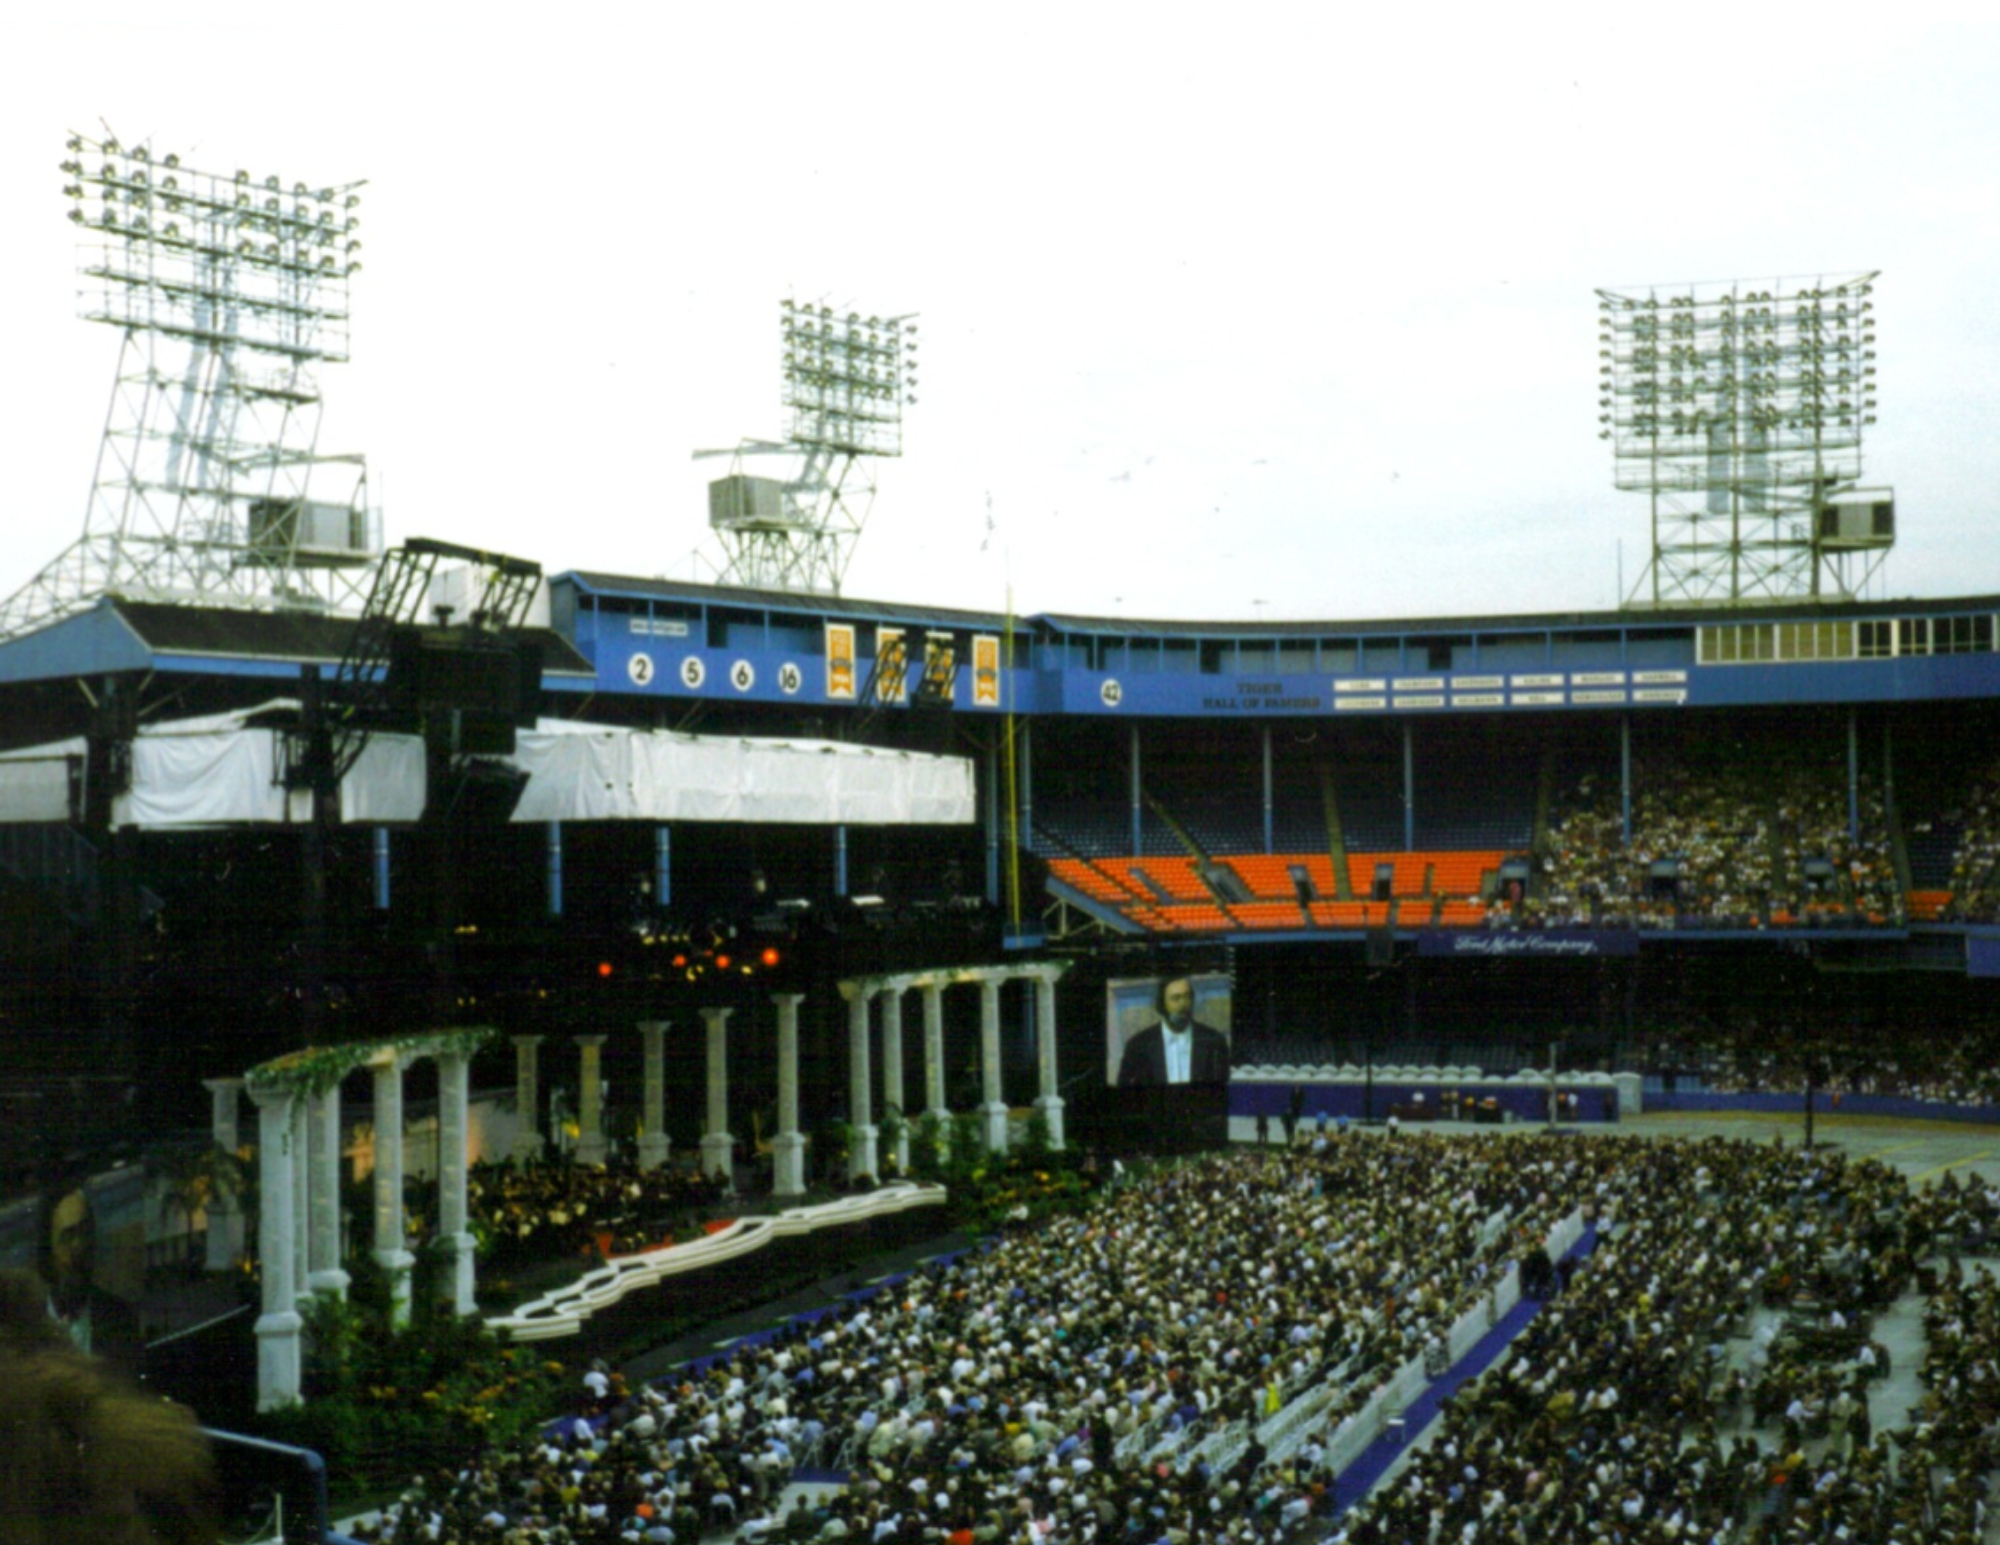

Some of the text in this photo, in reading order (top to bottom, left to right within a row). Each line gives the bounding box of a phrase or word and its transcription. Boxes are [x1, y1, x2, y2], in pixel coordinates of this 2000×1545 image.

[635, 657, 647, 681] 2
[687, 660, 699, 684] 5
[736, 664, 749, 687] 6
[781, 666, 798, 689] 16
[1103, 683, 1119, 701] 42
[1236, 683, 1283, 694] TIGER
[1203, 698, 1239, 709] HALL
[1242, 697, 1260, 709] OF
[1454, 935, 1489, 952] Ford
[1488, 935, 1530, 954] Motor
